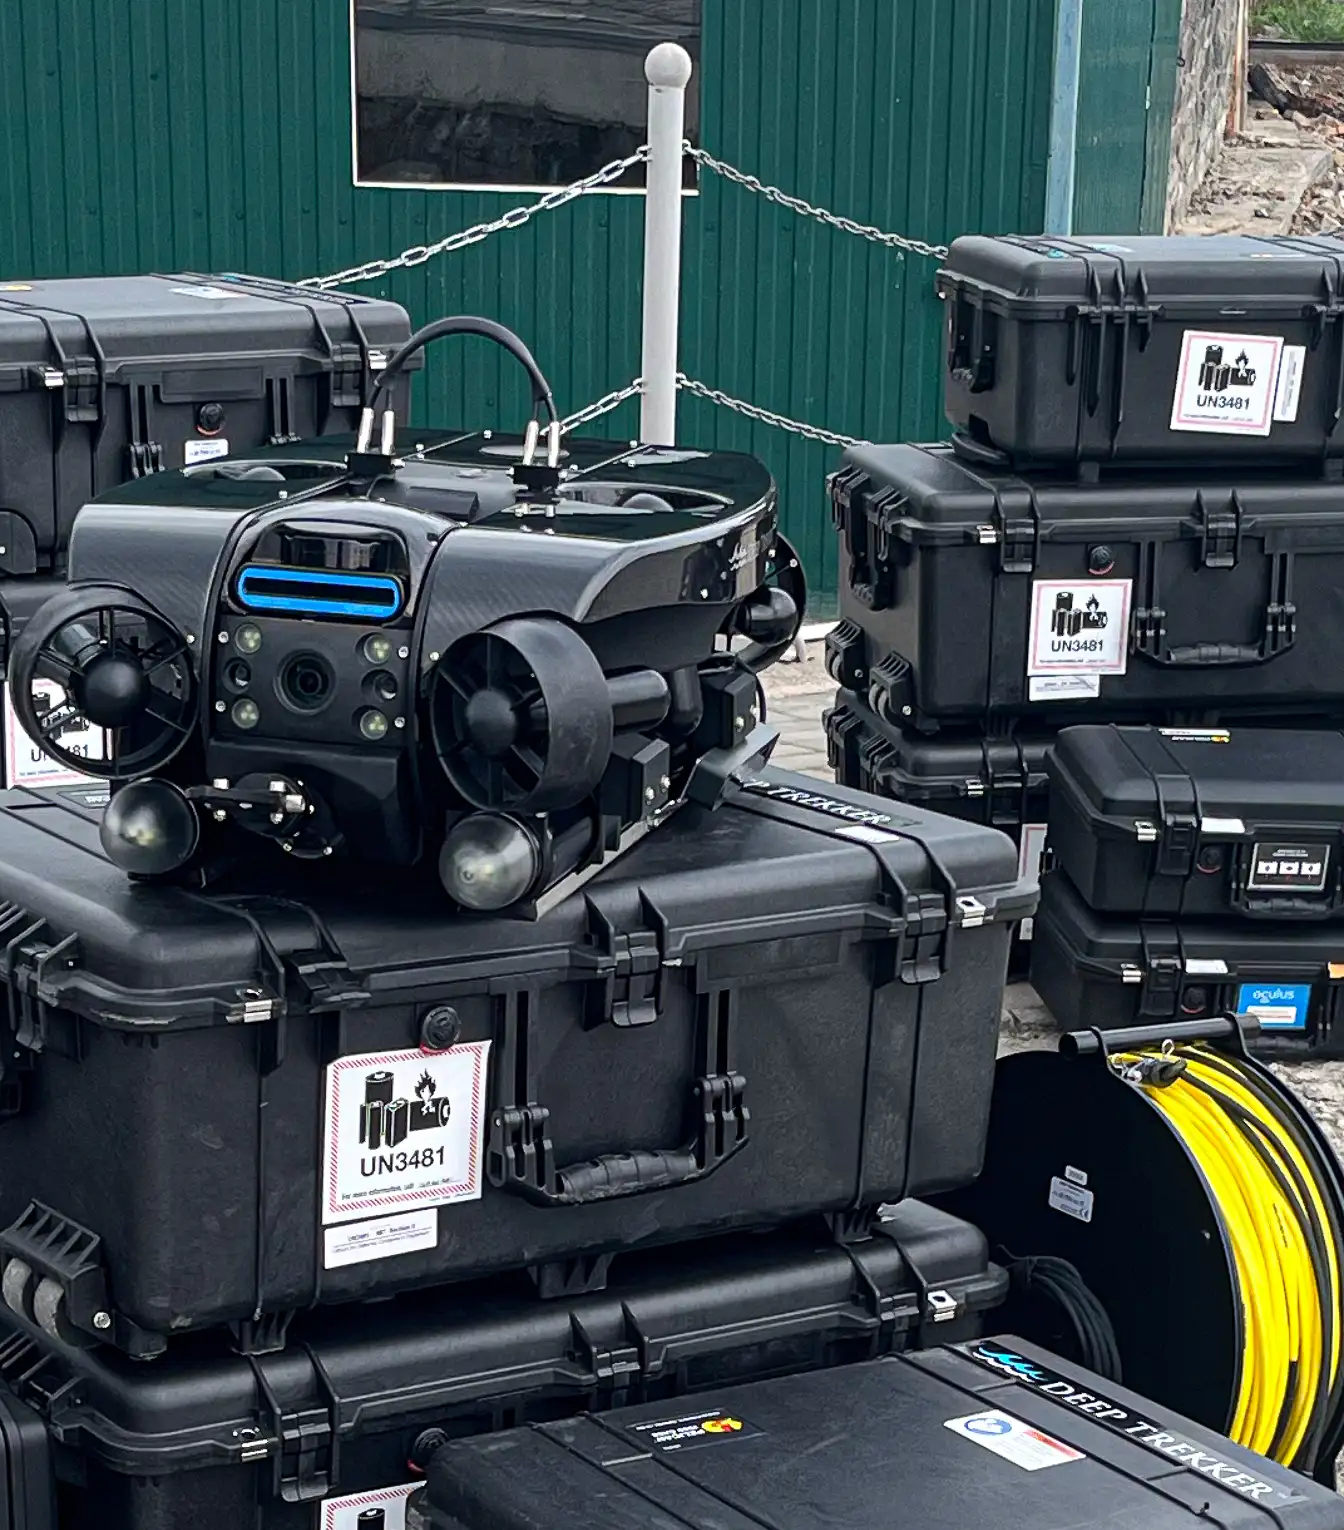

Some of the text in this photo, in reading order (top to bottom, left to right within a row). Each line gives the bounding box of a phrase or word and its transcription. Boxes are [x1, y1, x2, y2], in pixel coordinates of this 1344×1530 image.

[1197, 394, 1250, 410] UN3481
[1051, 639, 1104, 652] UN3481
[1252, 987, 1295, 1000] oculus
[360, 1146, 444, 1177] UN3481
[1039, 1381, 1128, 1429] DEEP
[1124, 1420, 1274, 1500] TREKKER
